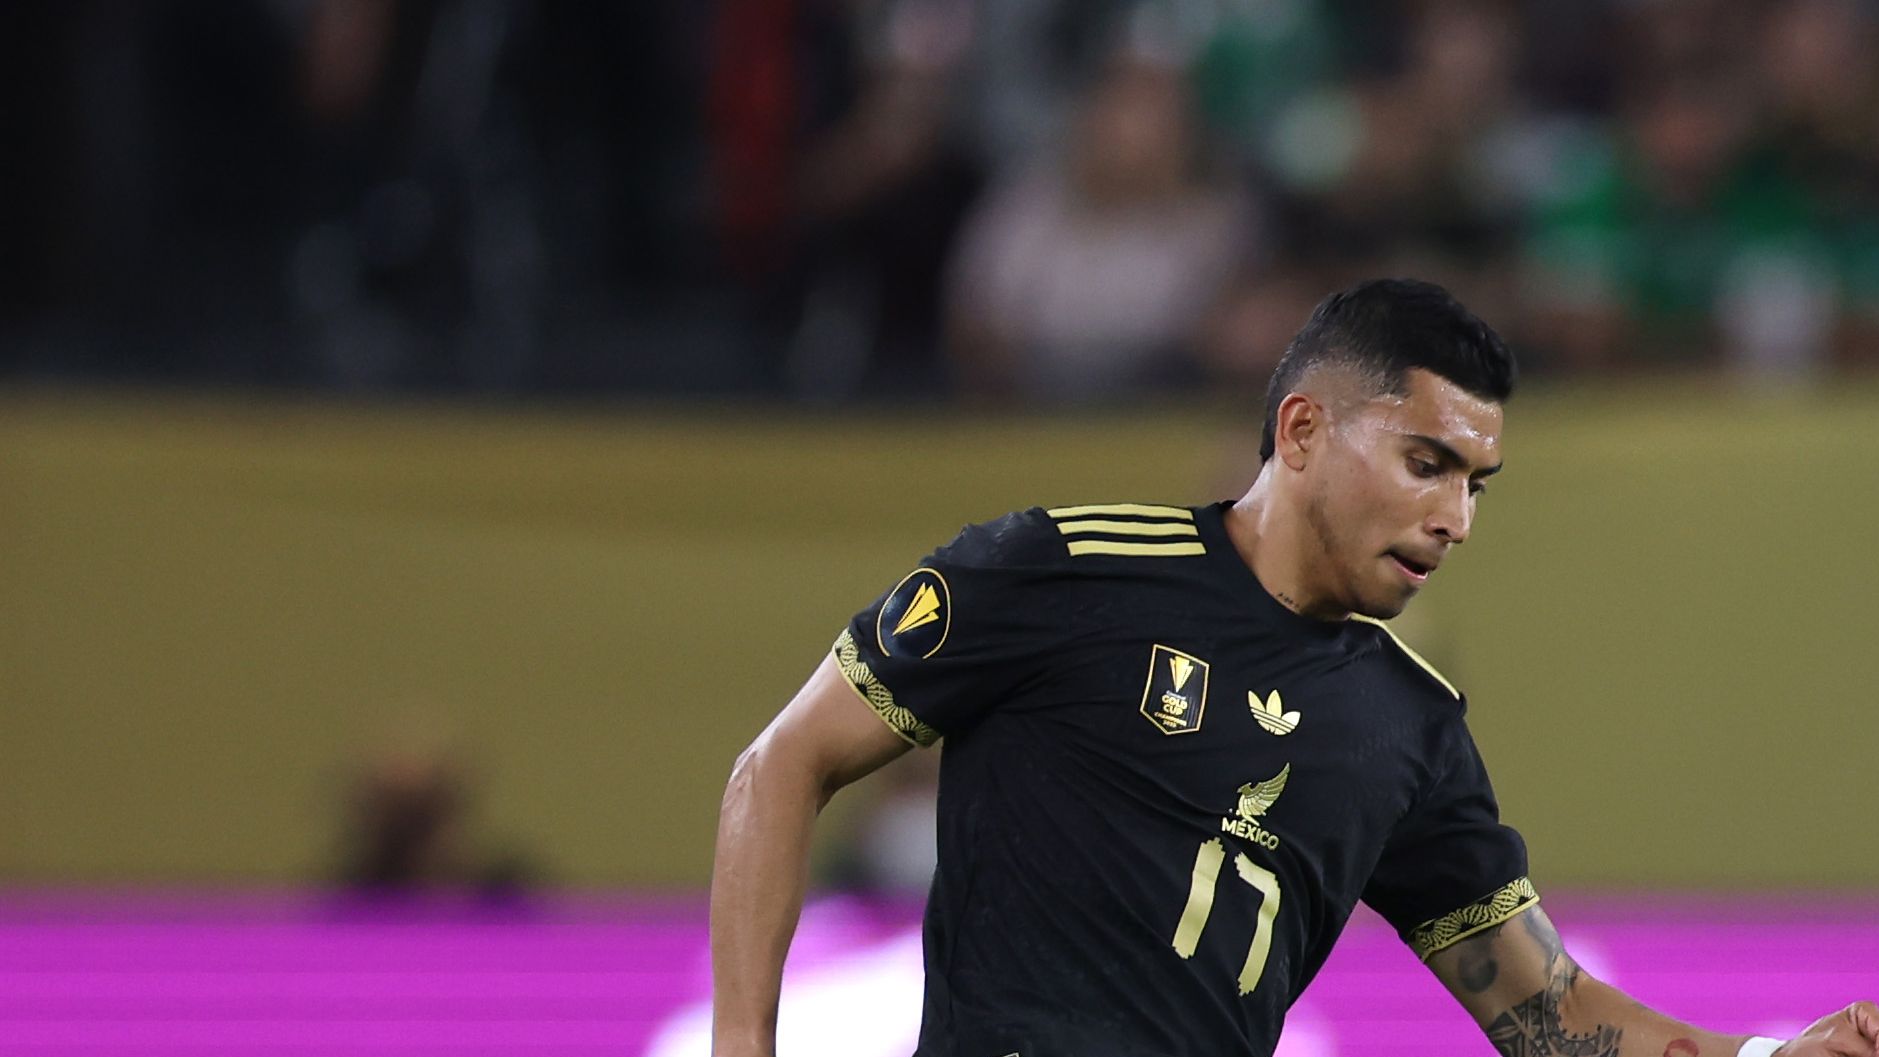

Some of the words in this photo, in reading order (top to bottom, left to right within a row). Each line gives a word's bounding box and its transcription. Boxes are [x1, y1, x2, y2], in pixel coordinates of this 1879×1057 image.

[1163, 704, 1183, 715] CUP
[1221, 816, 1280, 851] MÉXICO
[1172, 837, 1281, 996] 17
